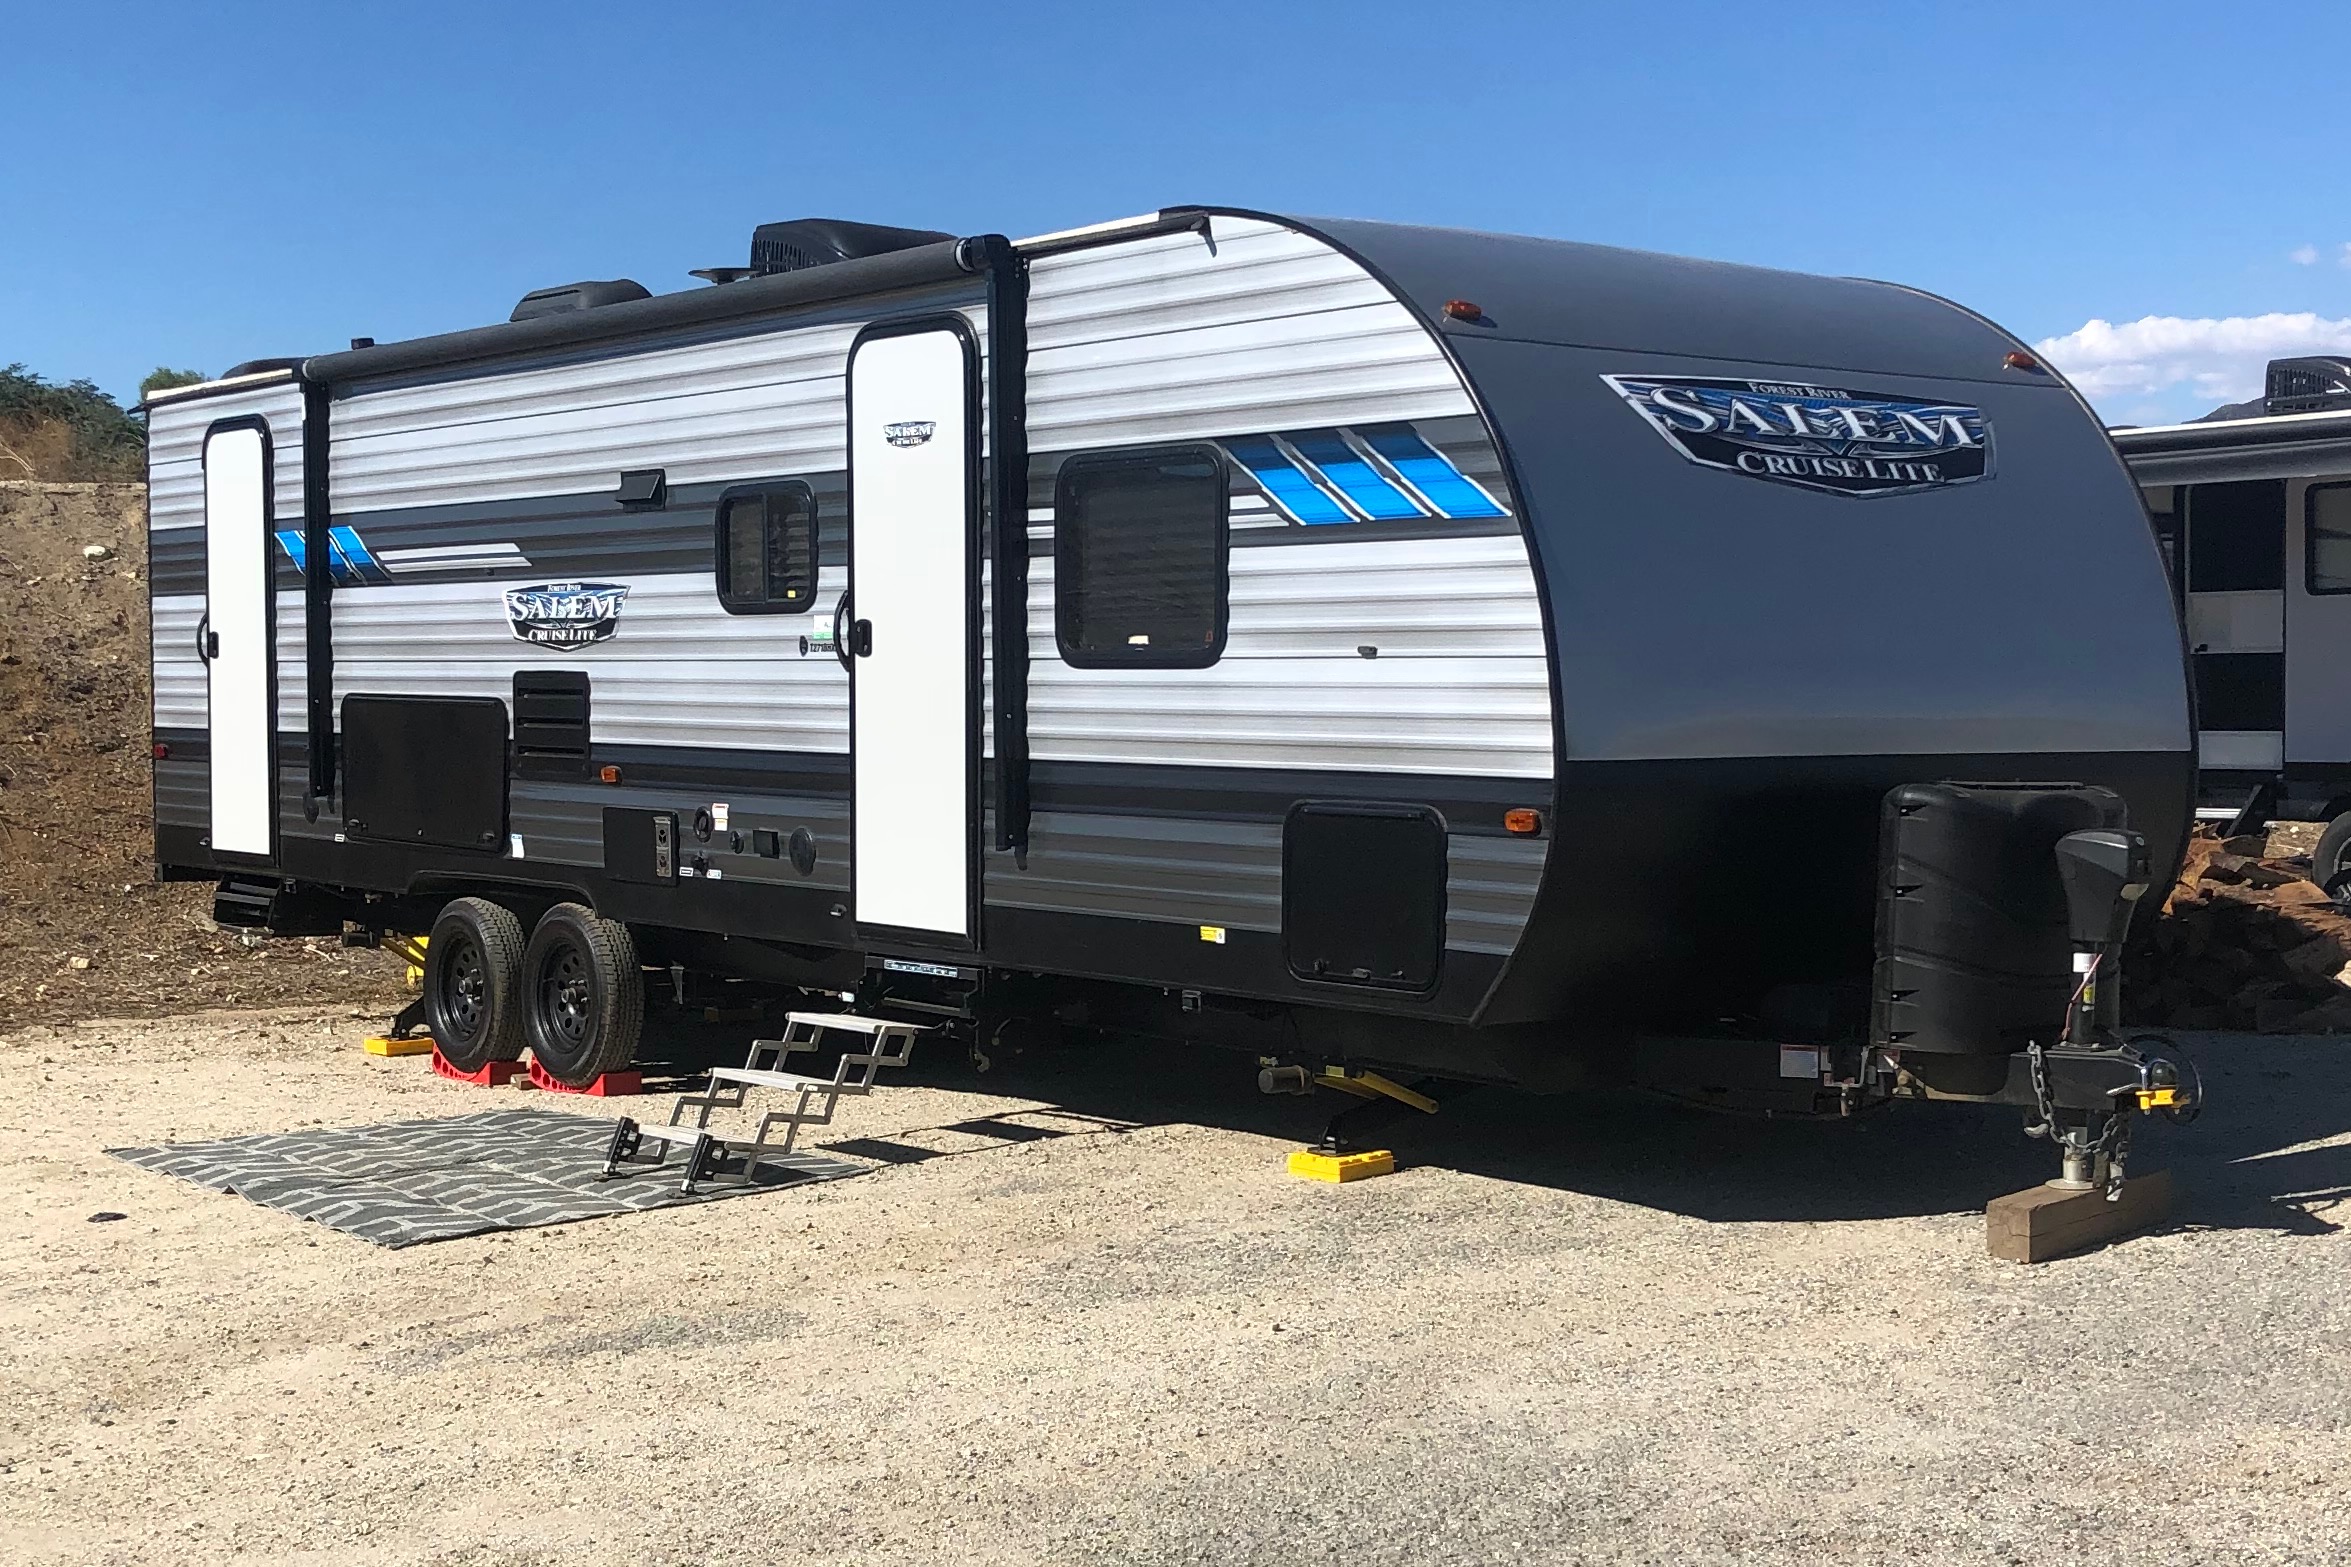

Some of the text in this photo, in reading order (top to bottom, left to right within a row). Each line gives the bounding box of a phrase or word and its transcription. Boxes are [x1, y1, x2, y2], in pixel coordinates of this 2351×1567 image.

[1747, 382, 1853, 400] FOREST RIVER
[1651, 386, 1975, 449] SALEM
[511, 595, 616, 620] SALEM
